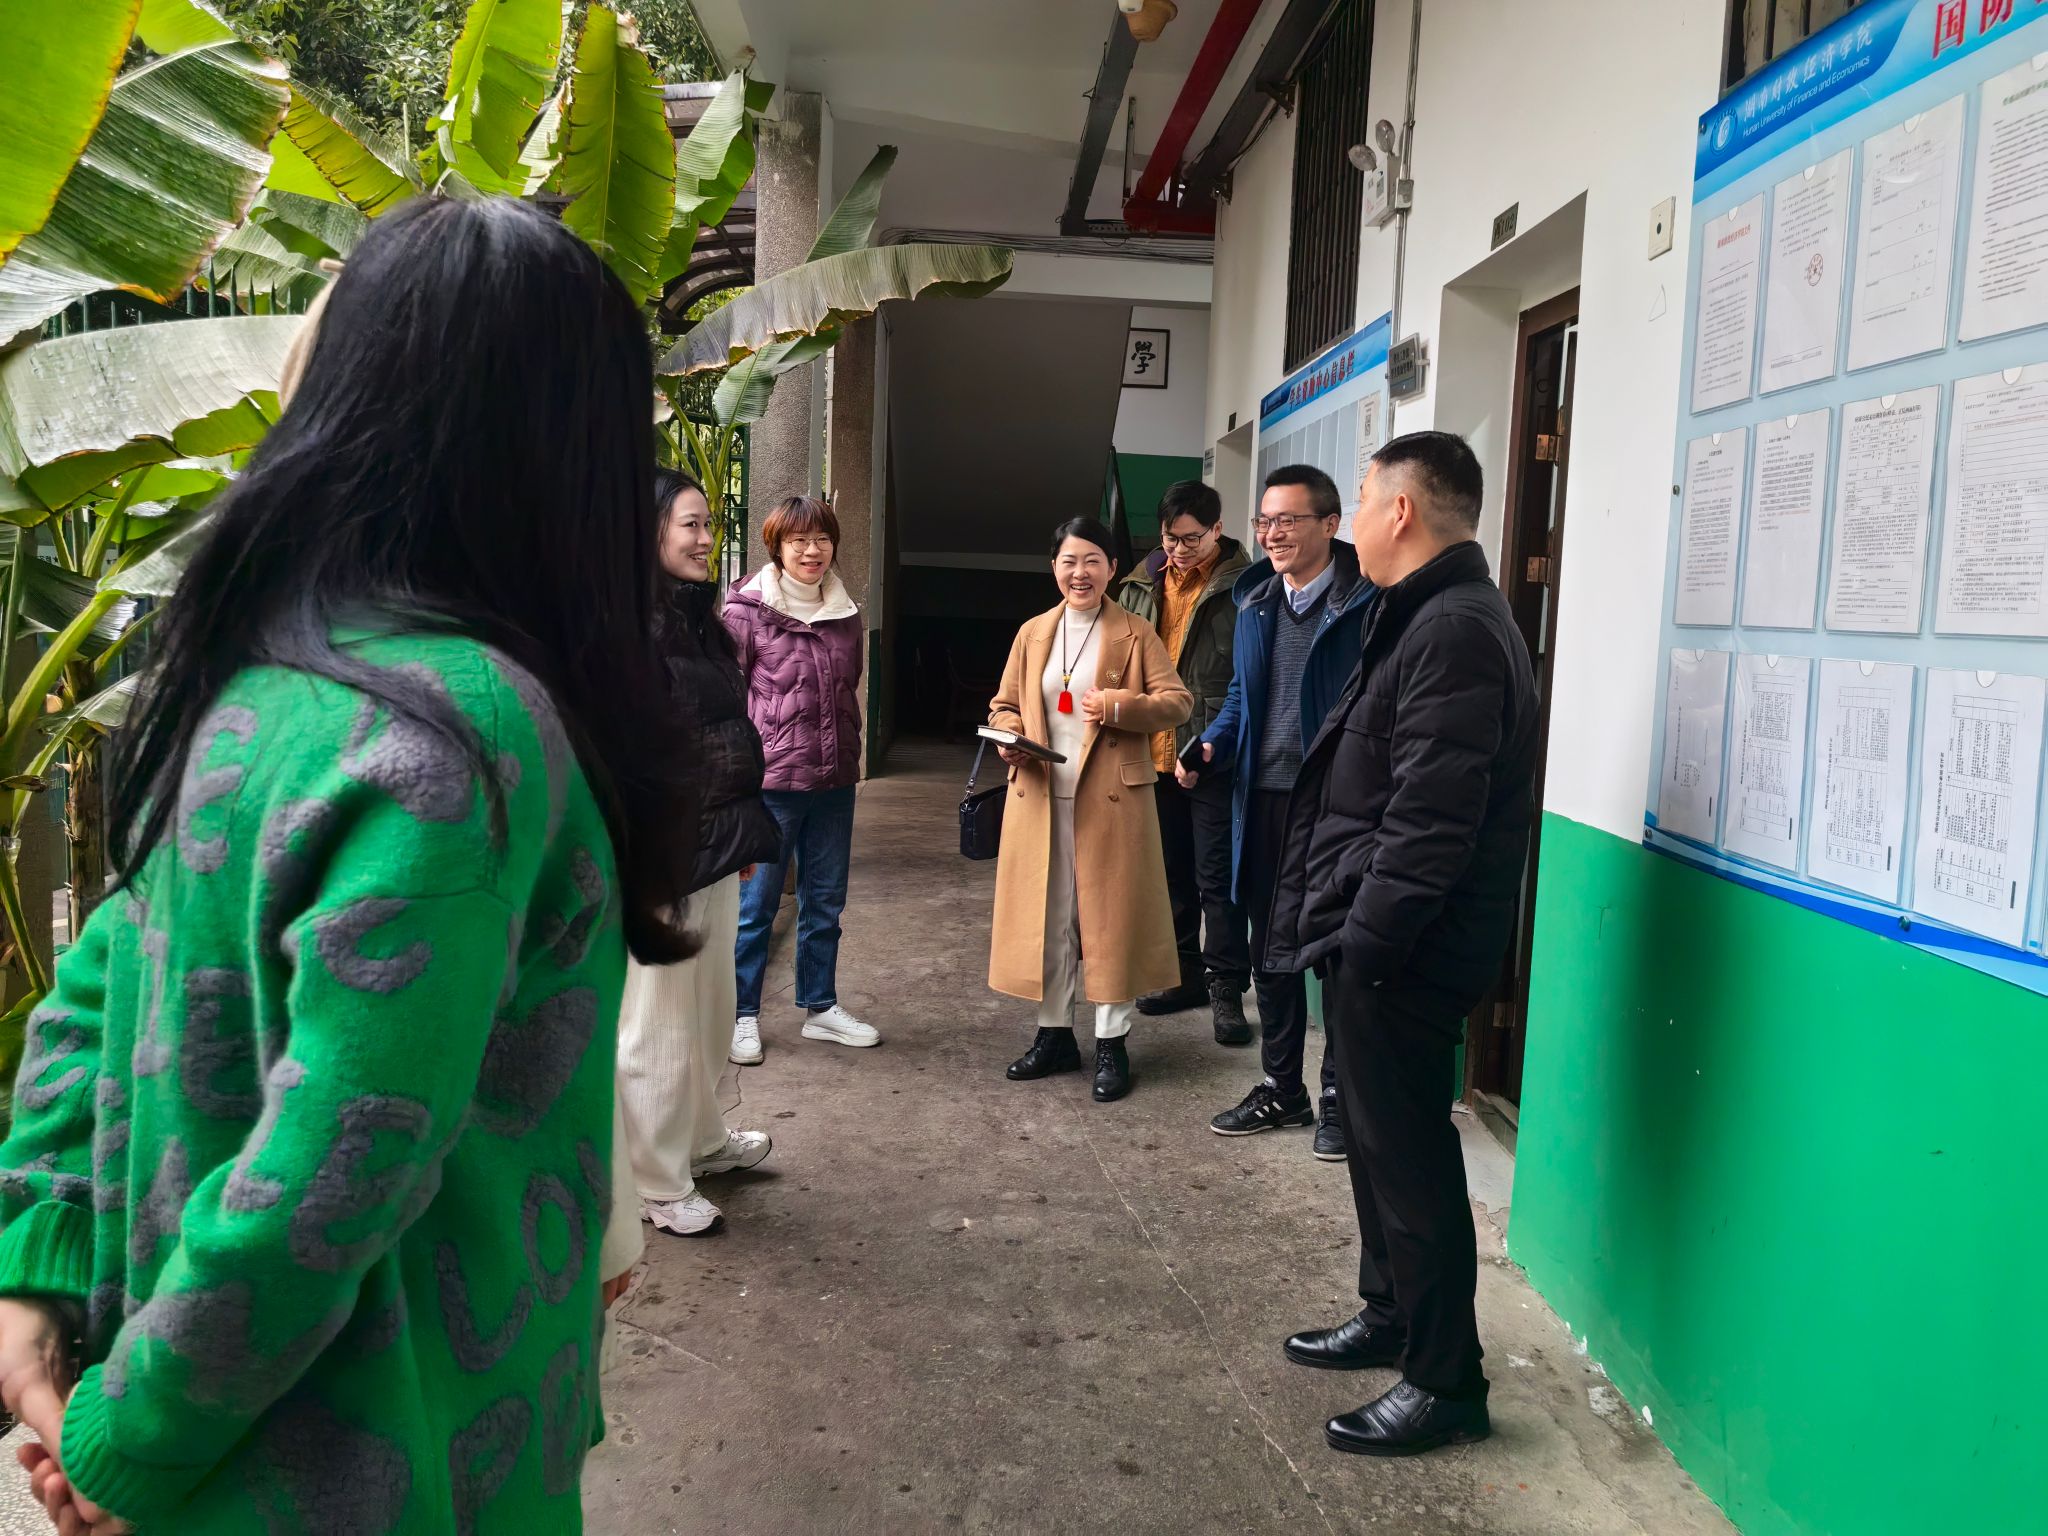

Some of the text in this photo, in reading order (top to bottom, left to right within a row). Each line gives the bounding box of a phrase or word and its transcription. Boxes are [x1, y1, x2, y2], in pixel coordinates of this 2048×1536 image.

[1743, 20, 1873, 122] 湖南财政经济学院
[1743, 121, 1760, 138] Hunan
[1761, 104, 1787, 128] University
[1793, 86, 1818, 108] Finance
[1818, 75, 1832, 92] and
[1832, 56, 1870, 85] Economics
